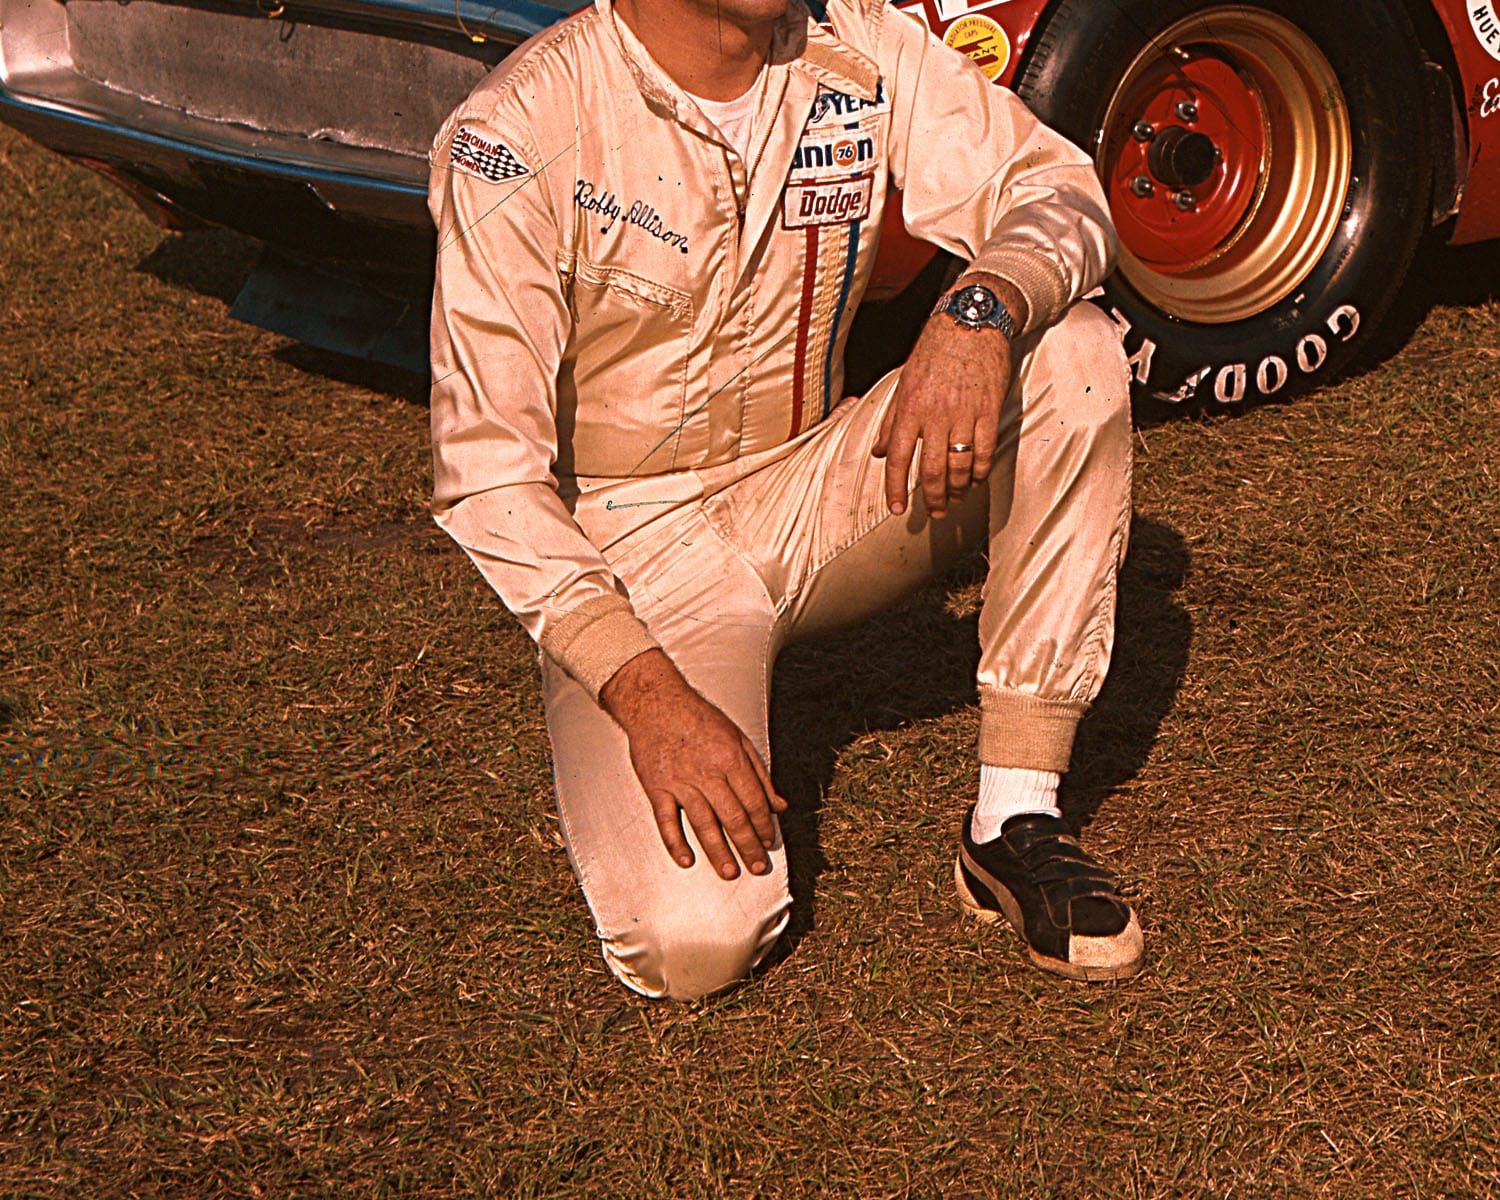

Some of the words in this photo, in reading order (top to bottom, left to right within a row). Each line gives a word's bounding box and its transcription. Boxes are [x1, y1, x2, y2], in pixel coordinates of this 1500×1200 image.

[966, 44, 998, 58] ANT
[573, 179, 622, 235] Bobby
[621, 200, 689, 254] Allison
[799, 187, 862, 220] Dodge
